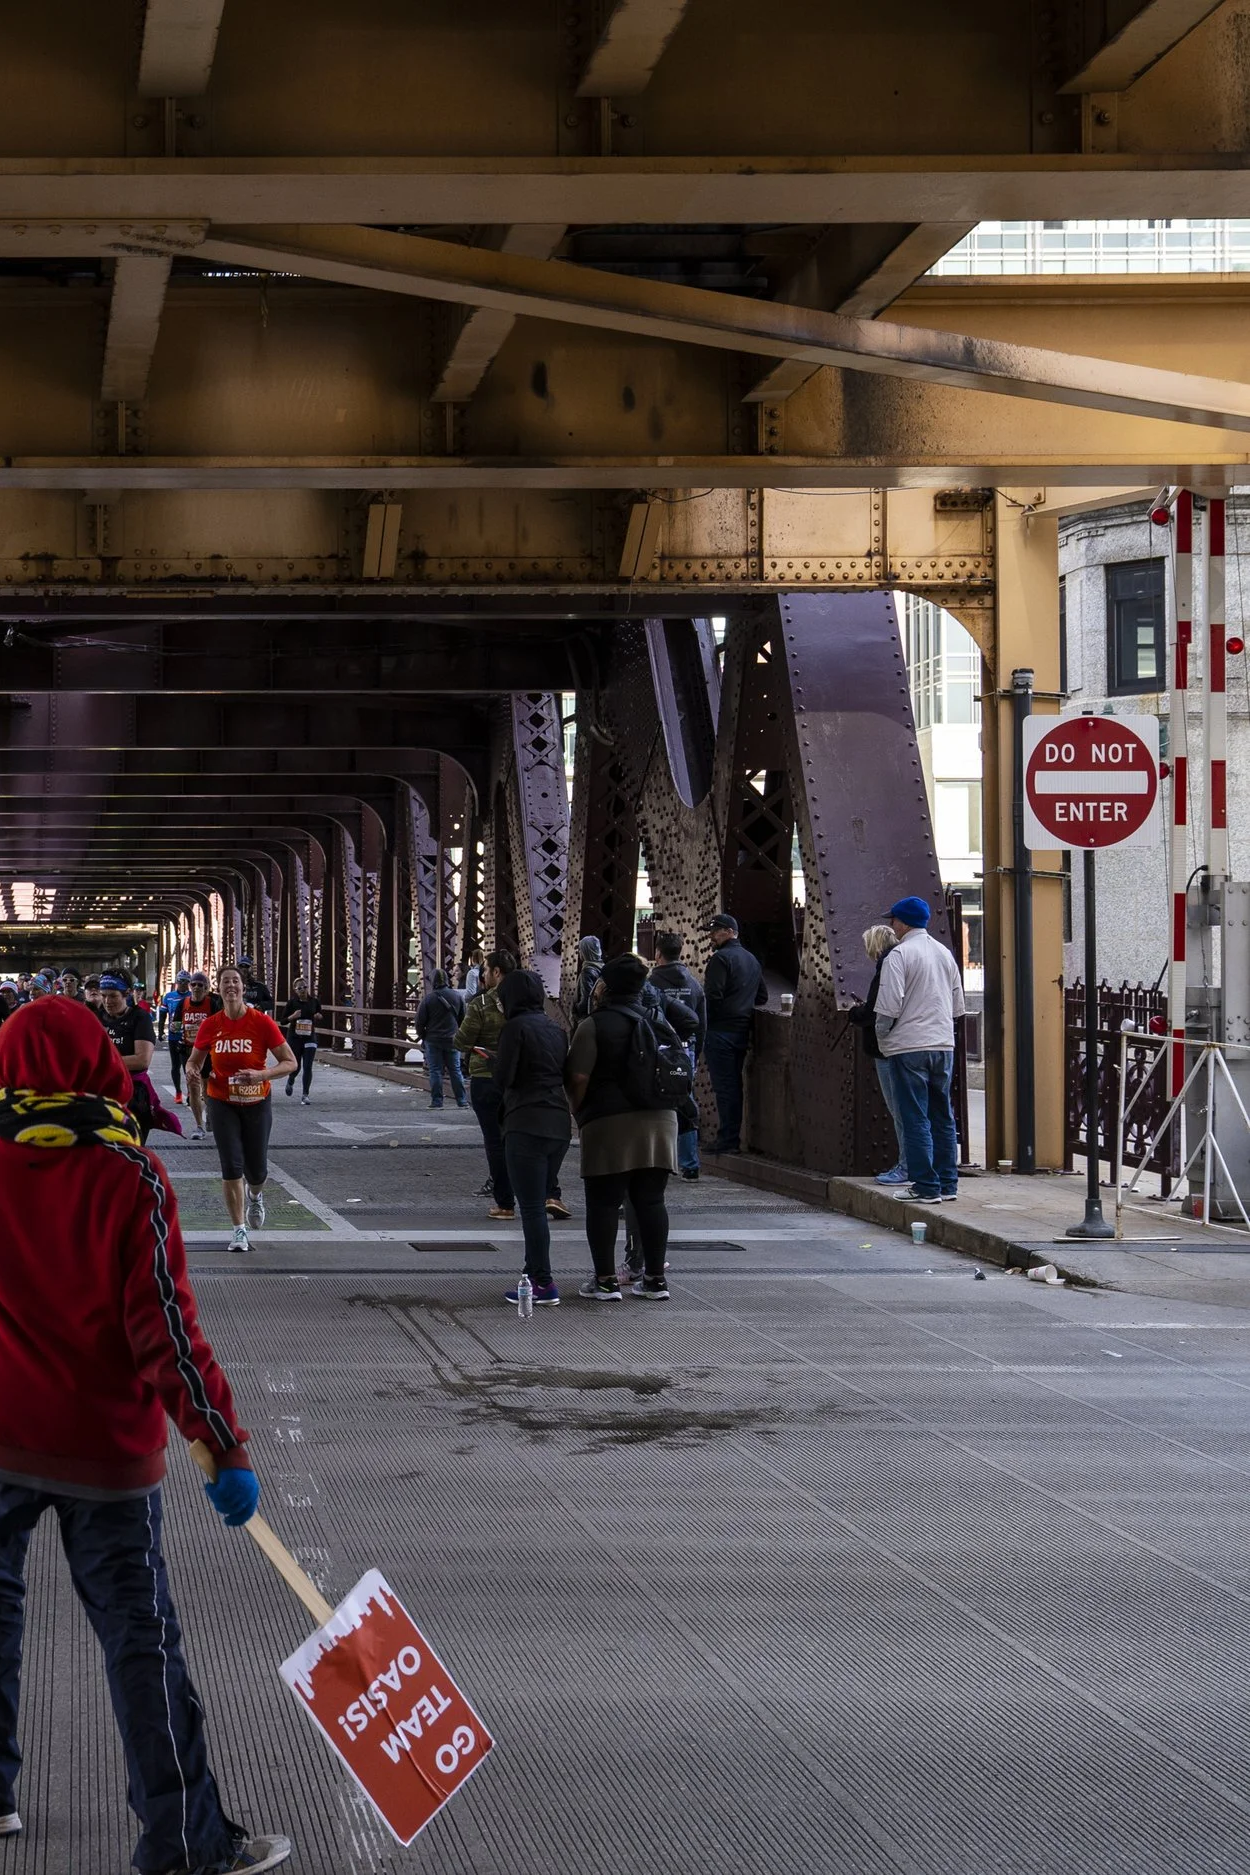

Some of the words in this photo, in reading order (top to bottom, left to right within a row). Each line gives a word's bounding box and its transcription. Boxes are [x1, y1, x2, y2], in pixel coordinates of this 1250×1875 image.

[1045, 743, 1075, 763] DO
[1091, 743, 1137, 763] NOT
[1055, 802, 1128, 821] ENTER
[184, 1012, 207, 1022] OASIS
[215, 1039, 252, 1053] OASIS
[238, 1085, 261, 1096] 62821
[337, 1645, 421, 1742] OASIS!
[380, 1685, 453, 1765] TEAM
[435, 1725, 476, 1774] GO
